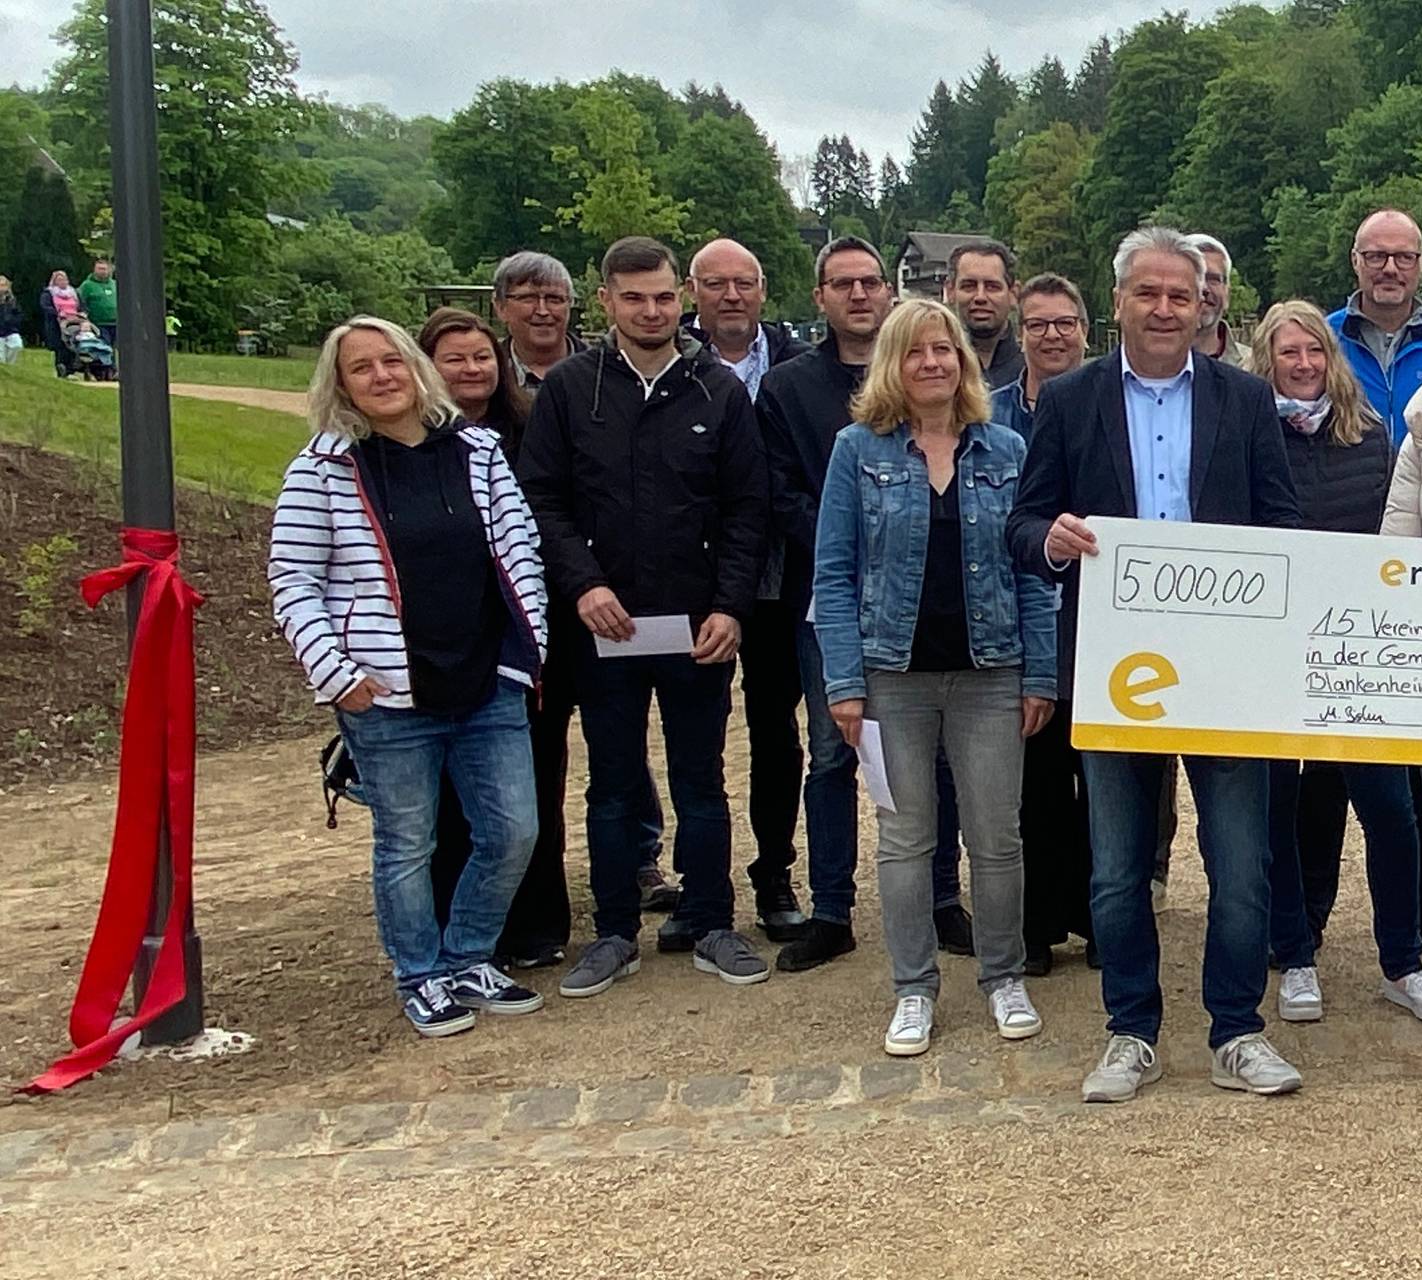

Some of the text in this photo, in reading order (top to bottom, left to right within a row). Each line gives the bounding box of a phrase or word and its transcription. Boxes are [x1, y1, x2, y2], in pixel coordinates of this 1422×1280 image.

[1311, 607, 1363, 635] 15
[1305, 647, 1322, 664] in
[1334, 641, 1369, 665] der
[1108, 651, 1180, 721] e
